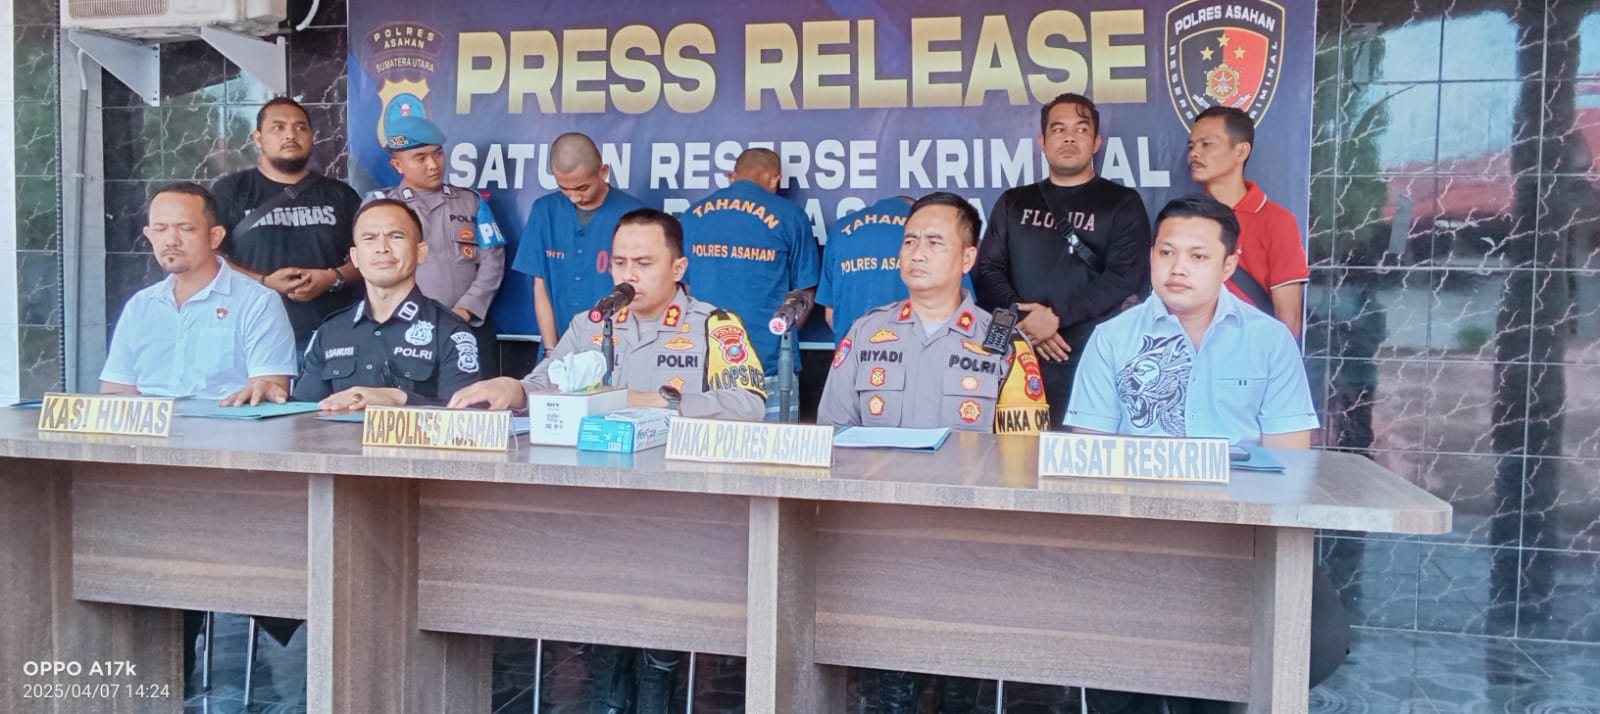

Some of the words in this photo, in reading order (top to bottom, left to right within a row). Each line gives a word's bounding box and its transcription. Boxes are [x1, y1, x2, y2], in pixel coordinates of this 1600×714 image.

[1174, 5, 1222, 35] POLRES
[1225, 4, 1276, 32] ASAHAN
[373, 26, 435, 42] POLRES
[384, 37, 425, 49] ASAHAN
[375, 57, 412, 73] SUMATERA
[412, 58, 434, 73] UTARA
[456, 22, 717, 115] PRESS
[744, 8, 1148, 111] RELEASE
[449, 142, 632, 190] SATUN
[650, 139, 878, 190] RESRSE
[899, 136, 1172, 189] KRIMAL
[692, 198, 780, 230] TAHANAN
[1020, 208, 1095, 232] FLOIDA
[731, 245, 776, 262] ASAHAN
[393, 346, 433, 360] POLRI
[657, 354, 698, 368] POLRI
[860, 349, 903, 364] RIYADI
[949, 354, 997, 374] POLRI
[96, 399, 169, 434] HUMAS
[997, 409, 1031, 432] WAKA
[365, 410, 442, 446] KAPOLRES
[444, 411, 507, 448] ASAHAN
[669, 420, 710, 458] WAKA
[713, 423, 769, 459] POLRES
[770, 426, 834, 465] ASAHAN
[1043, 436, 1117, 475] KASAT
[1123, 439, 1227, 481] RESKRIM
